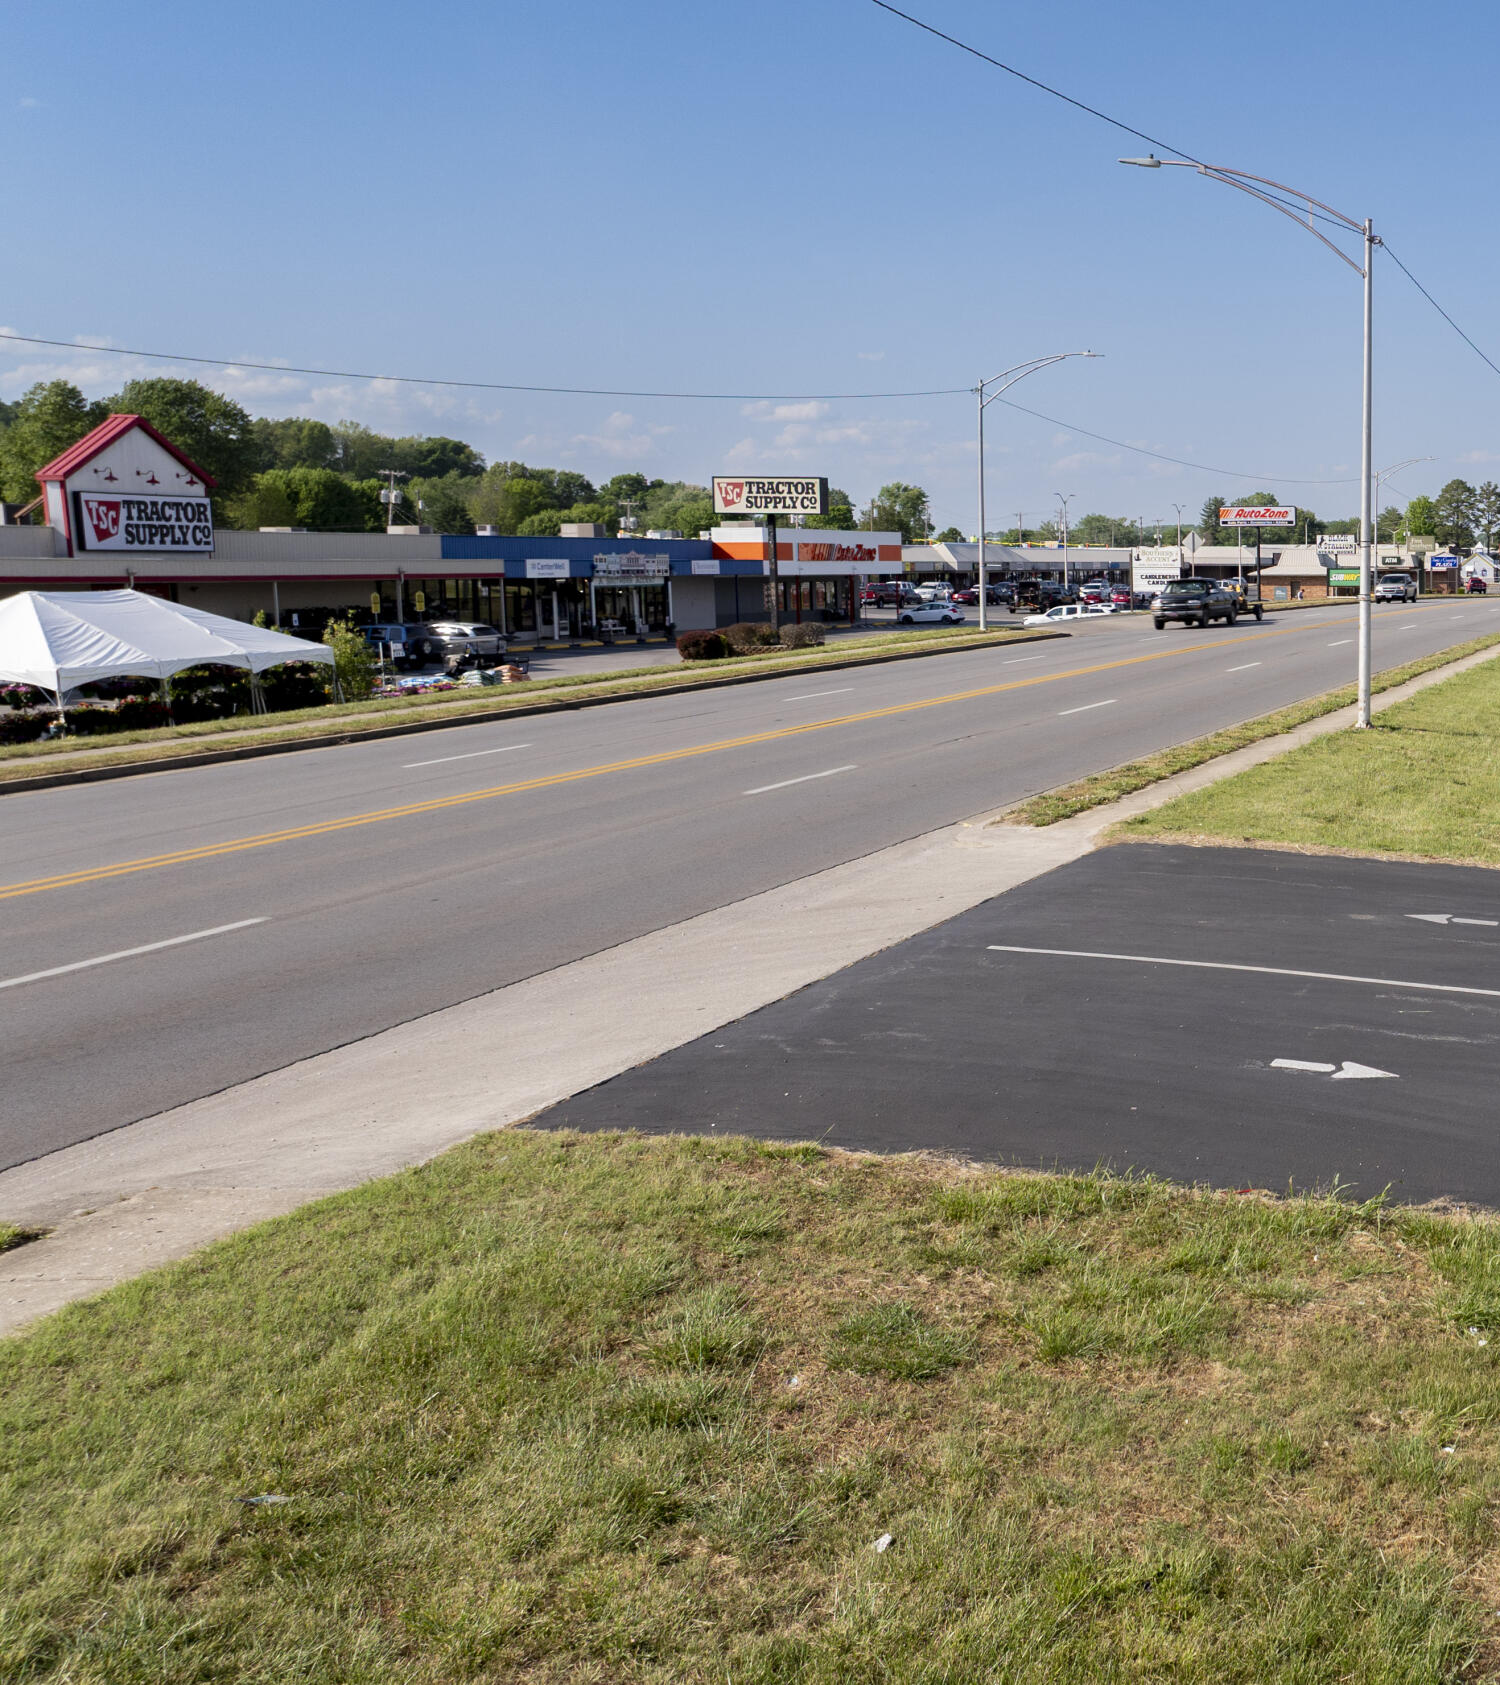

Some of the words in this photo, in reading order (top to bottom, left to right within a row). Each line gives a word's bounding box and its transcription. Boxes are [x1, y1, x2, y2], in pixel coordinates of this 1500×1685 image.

[720, 483, 740, 502] TSC
[745, 481, 816, 495] TRACTOR
[122, 499, 210, 523] TRACTOR
[745, 496, 799, 509] SUPPLY
[88, 501, 118, 535] TSC
[1235, 508, 1288, 519] AutoZone
[125, 523, 190, 545] SUPPLY
[833, 543, 877, 561] AutoZone
